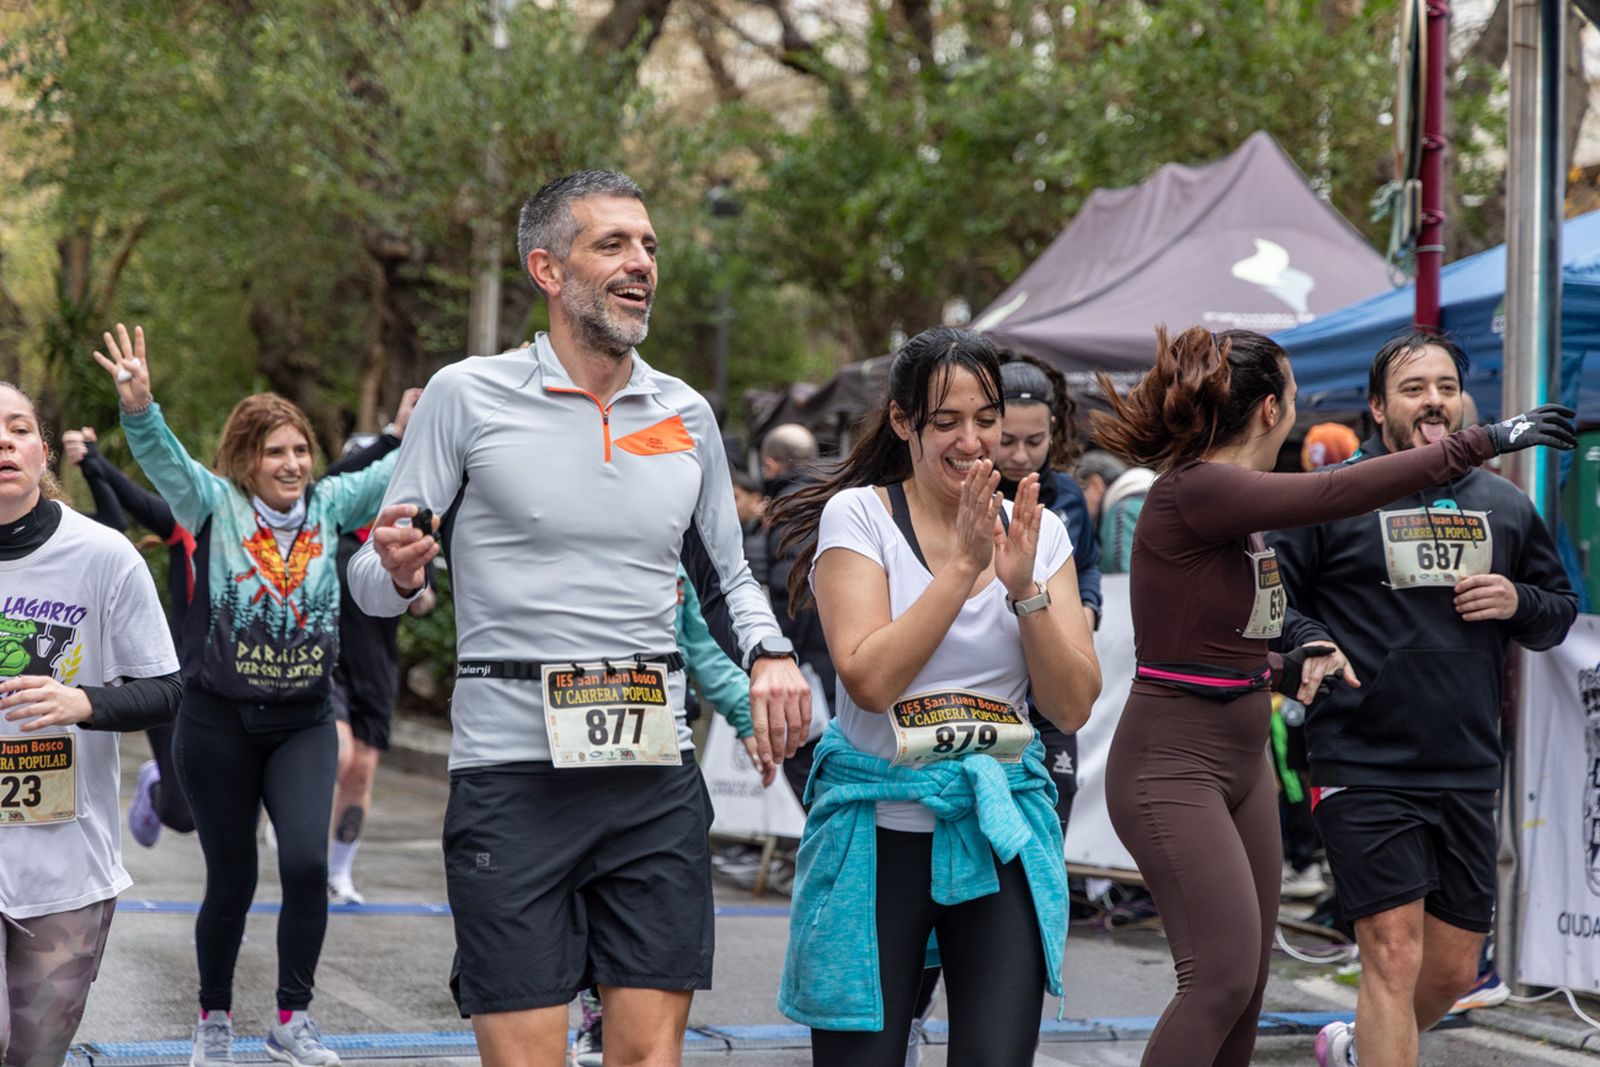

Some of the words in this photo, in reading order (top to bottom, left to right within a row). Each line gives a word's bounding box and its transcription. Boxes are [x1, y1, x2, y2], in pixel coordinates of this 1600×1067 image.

[1453, 516, 1479, 526] Boco
[1401, 528, 1444, 539] CARREA
[1445, 528, 1483, 539] POPUAR
[1416, 543, 1465, 571] 637
[4, 596, 88, 626] LAGARTO
[556, 674, 574, 688] IES
[576, 674, 600, 686] San
[603, 672, 631, 685] Juan
[632, 670, 657, 685] Bosco
[554, 690, 562, 705] V
[566, 688, 619, 705] CARRERA
[622, 686, 664, 703] POPULAR
[901, 701, 921, 715] IES
[923, 696, 947, 709] San
[949, 694, 977, 707] Juan
[976, 698, 1009, 713] Bosco
[585, 708, 646, 746] 877
[902, 715, 911, 727] V
[914, 707, 968, 726] CARRERA
[969, 708, 1019, 724] POPULAR
[1, 743, 28, 754] Juan
[31, 740, 64, 752] Bosco
[932, 724, 998, 754] 879
[18, 753, 68, 770] POPULAR
[1, 774, 42, 808] 23
